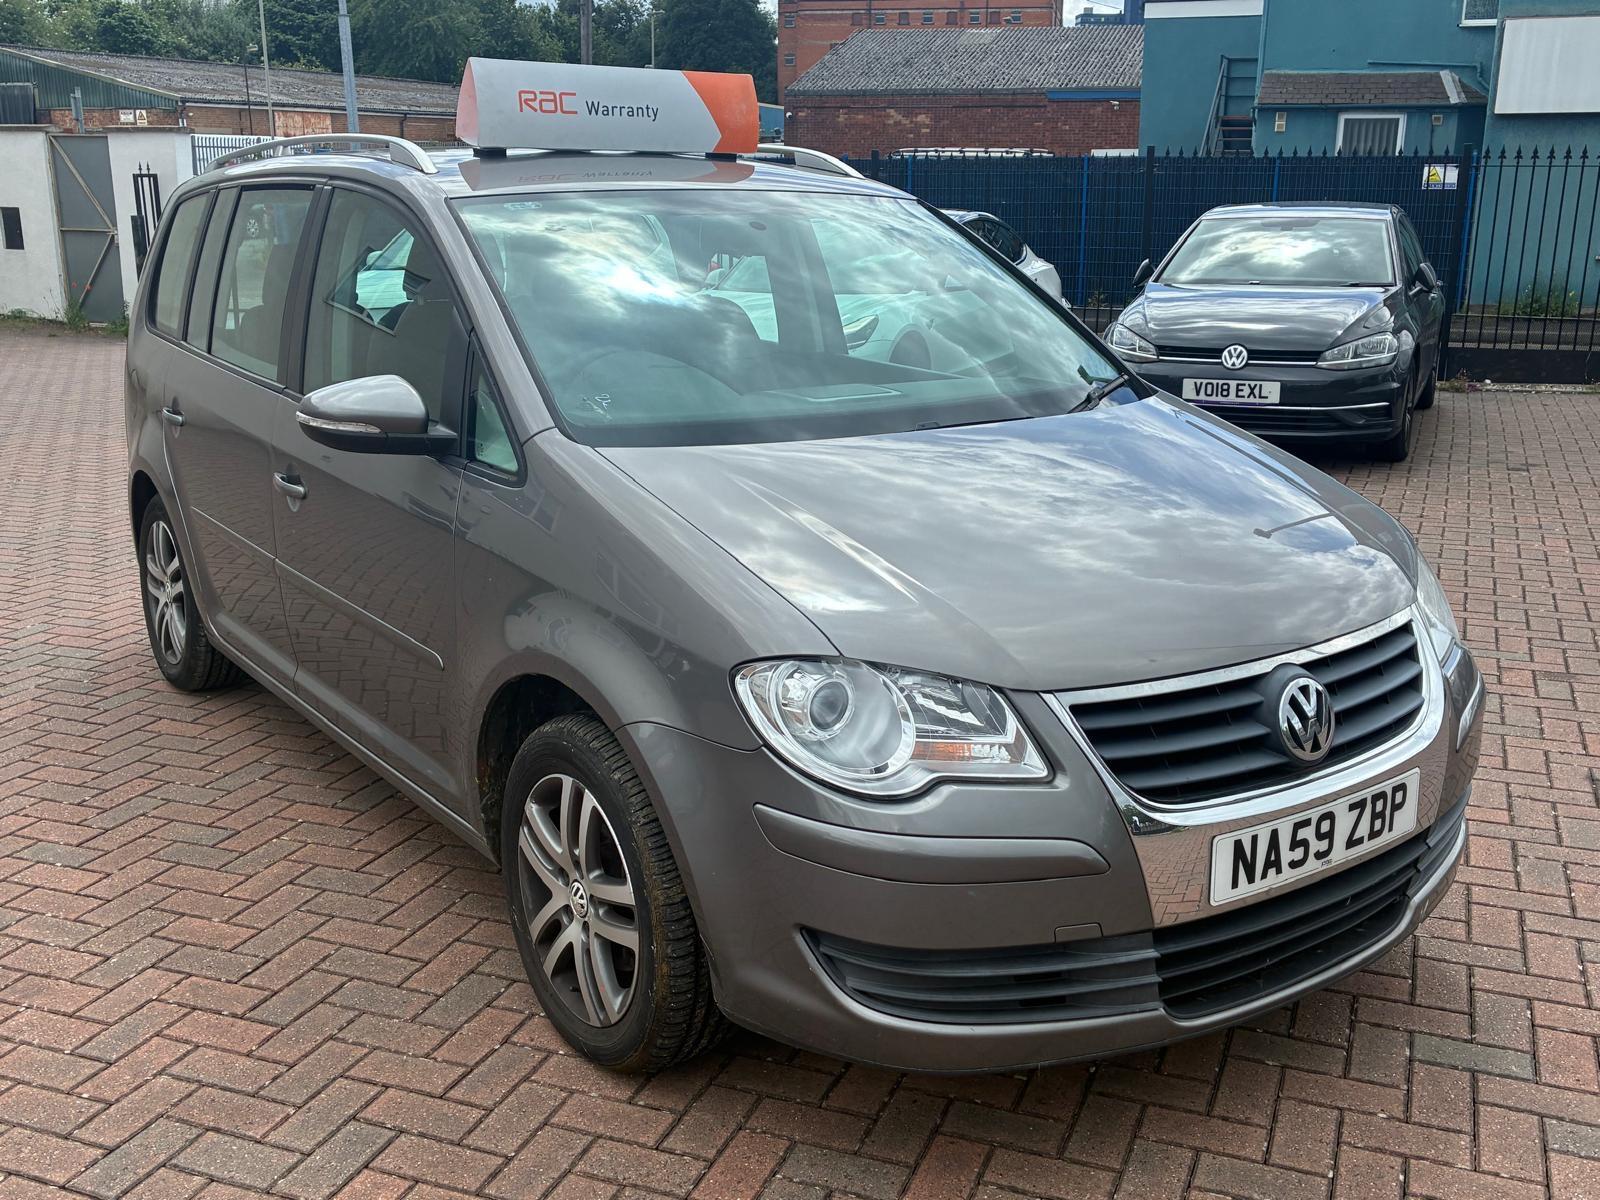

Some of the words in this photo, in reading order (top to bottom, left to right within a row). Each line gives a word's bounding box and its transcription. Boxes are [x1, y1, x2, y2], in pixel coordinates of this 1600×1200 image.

[585, 100, 659, 122] Warranty
[1193, 381, 1231, 398] VO18
[1235, 383, 1269, 399] EXL
[1231, 810, 1336, 890] NA59
[1345, 782, 1408, 850] ZBP
